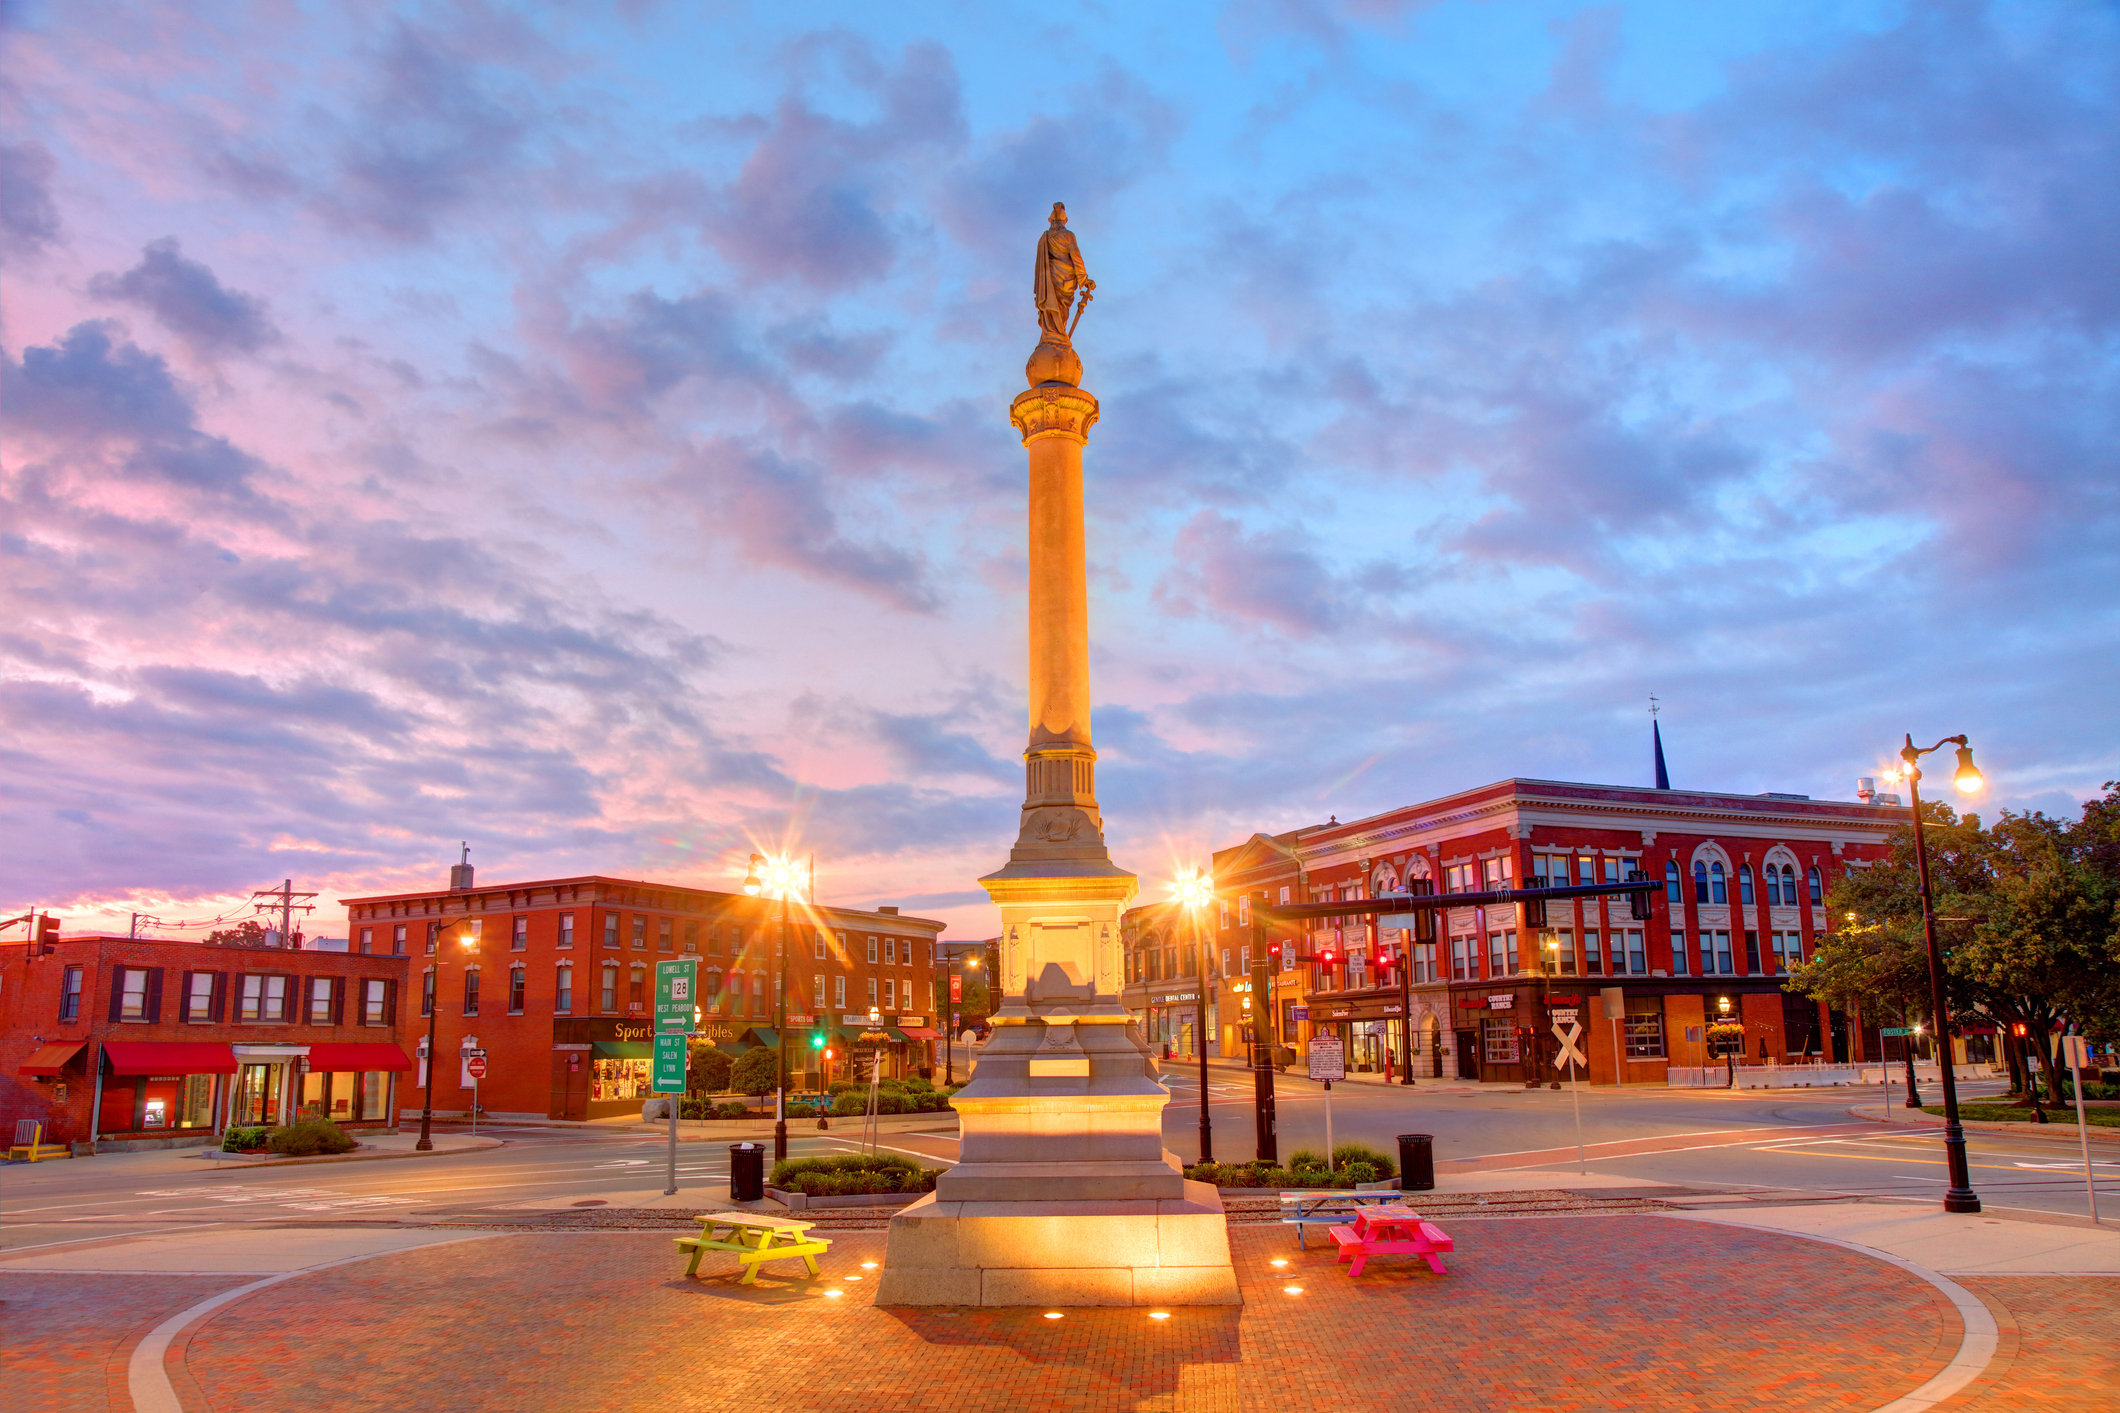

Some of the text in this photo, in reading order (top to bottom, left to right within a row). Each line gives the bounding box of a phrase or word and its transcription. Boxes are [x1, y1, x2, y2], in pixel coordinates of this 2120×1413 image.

[663, 964, 690, 974] LOWELL ST
[663, 982, 687, 995] TO 128
[1151, 993, 1196, 1004] GENTLE DENTAL CENTER
[657, 1003, 693, 1013] WEST PEABODY
[790, 1015, 805, 1023] SPORTS
[695, 1025, 733, 1038] ctibles
[660, 1038, 681, 1047] MAIN ST
[662, 1051, 678, 1060] SALEM
[663, 1064, 676, 1073] LYNN
